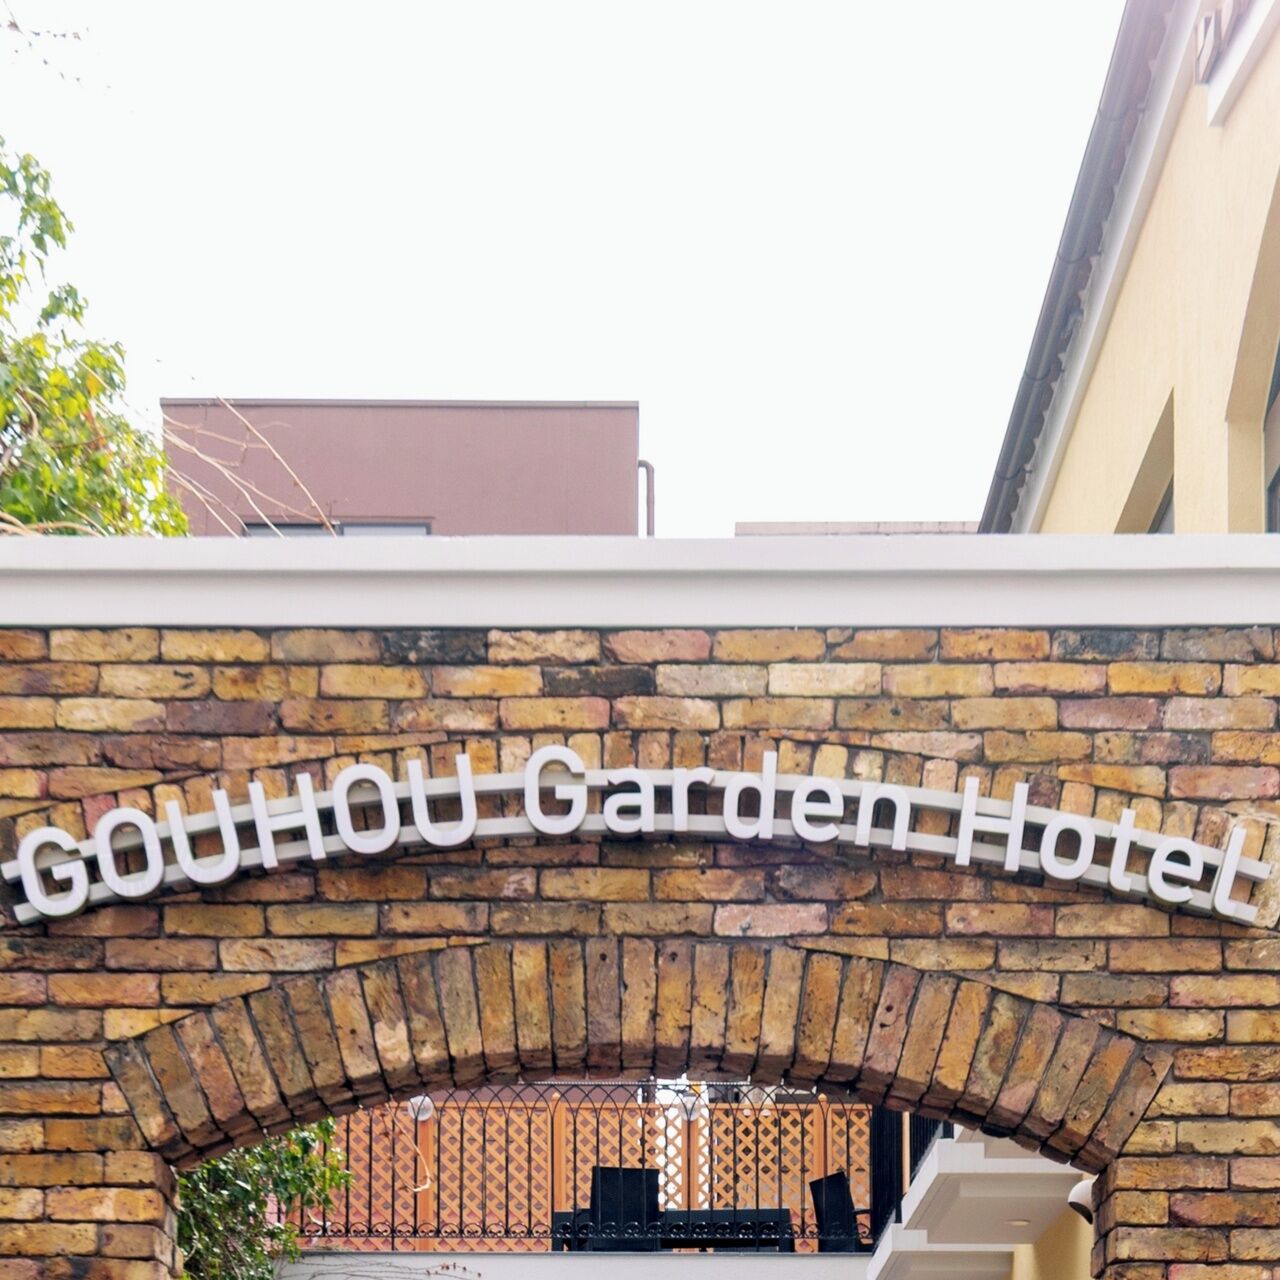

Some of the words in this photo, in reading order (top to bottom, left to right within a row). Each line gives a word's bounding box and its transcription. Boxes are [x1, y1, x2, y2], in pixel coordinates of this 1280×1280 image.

[19, 751, 479, 917] GOUHOU
[524, 745, 911, 852] Garden
[954, 776, 1254, 921] Hotel
